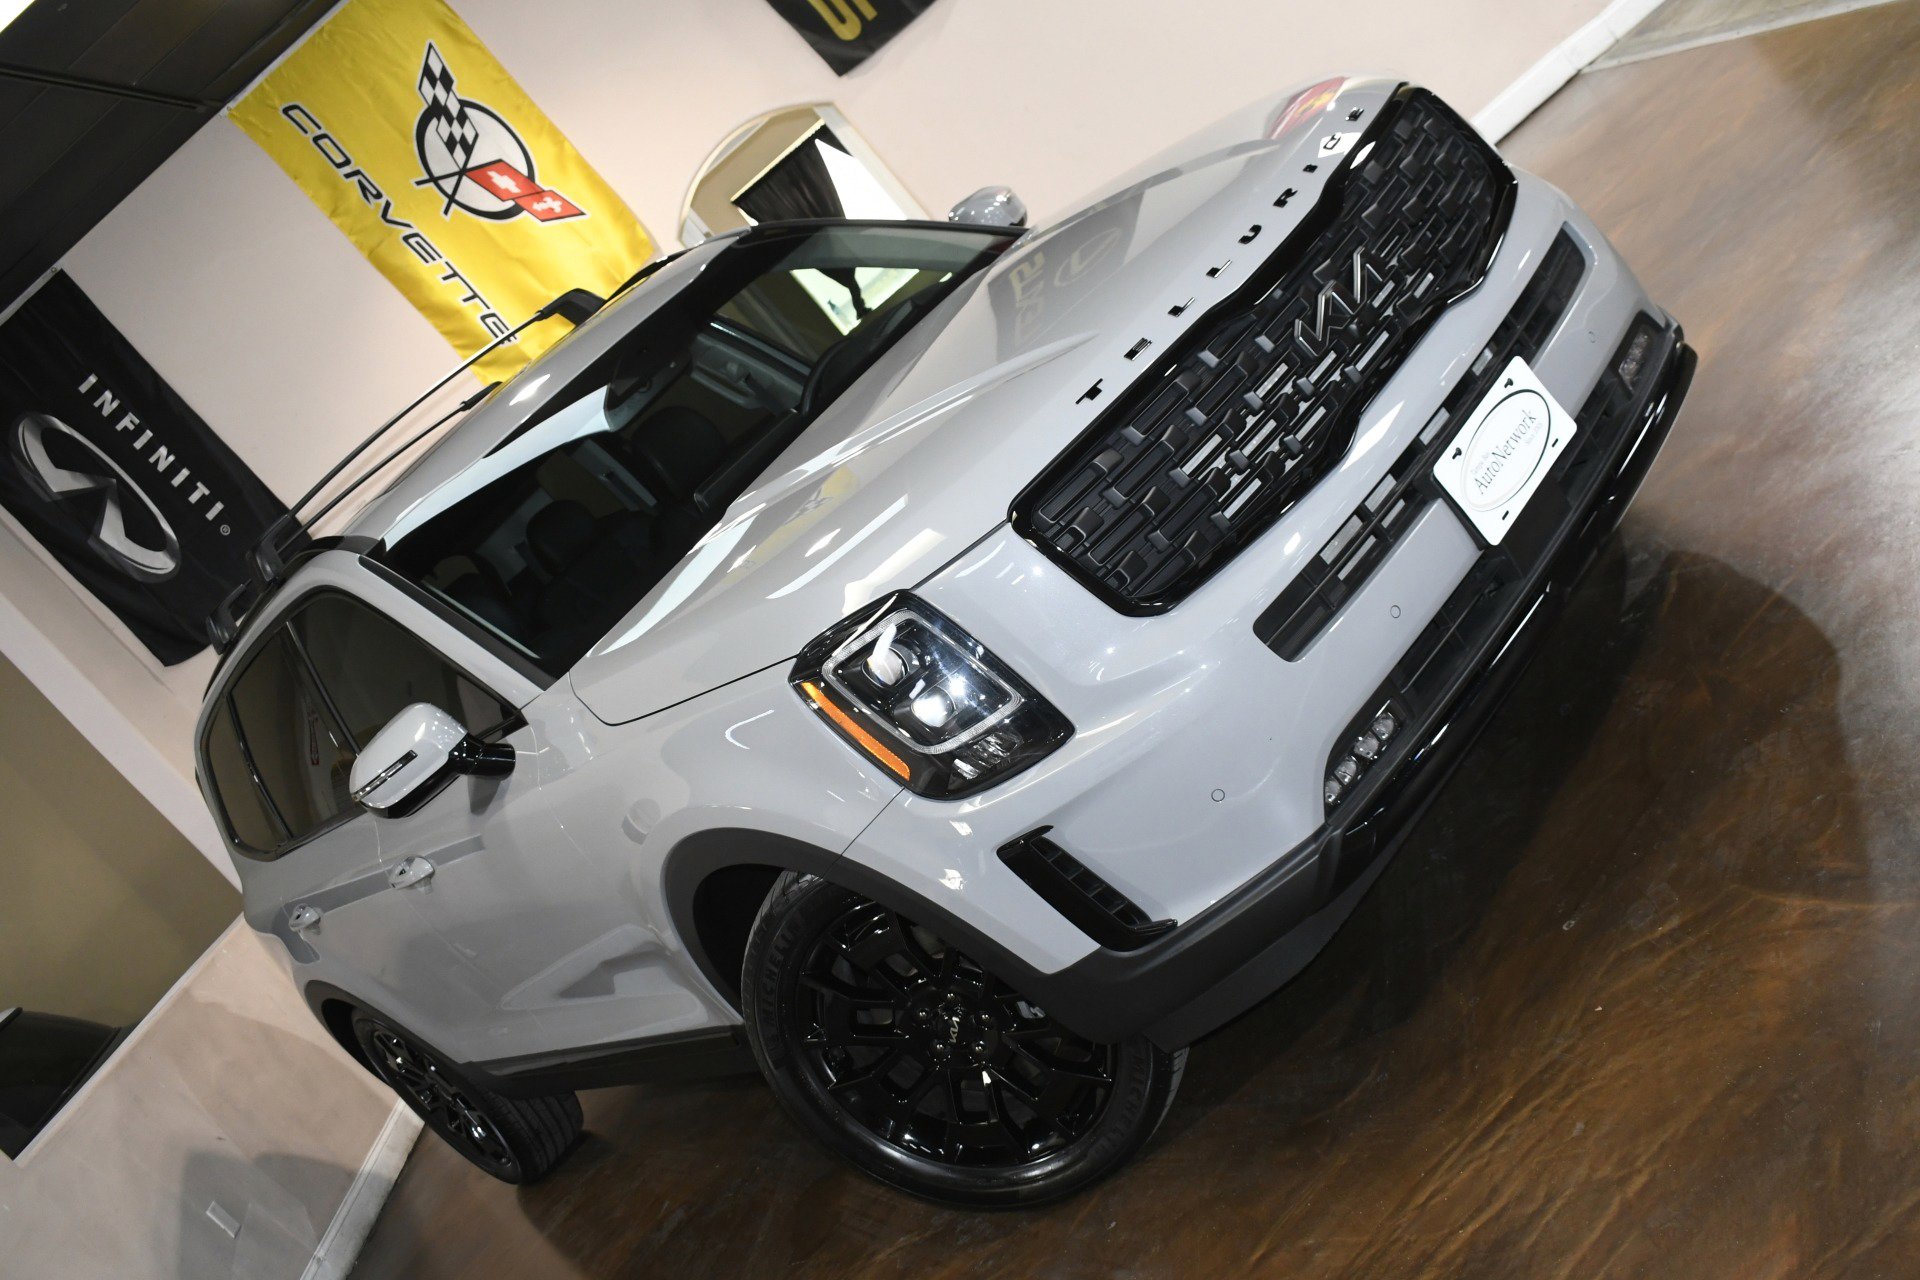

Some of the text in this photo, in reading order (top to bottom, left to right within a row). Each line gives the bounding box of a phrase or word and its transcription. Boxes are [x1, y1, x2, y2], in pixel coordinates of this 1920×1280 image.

[282, 104, 518, 345] CORVETTE
[1074, 106, 1365, 404] TELLURIDE
[78, 373, 225, 522] INFINITI
[1474, 409, 1537, 495] AutoNetwork
